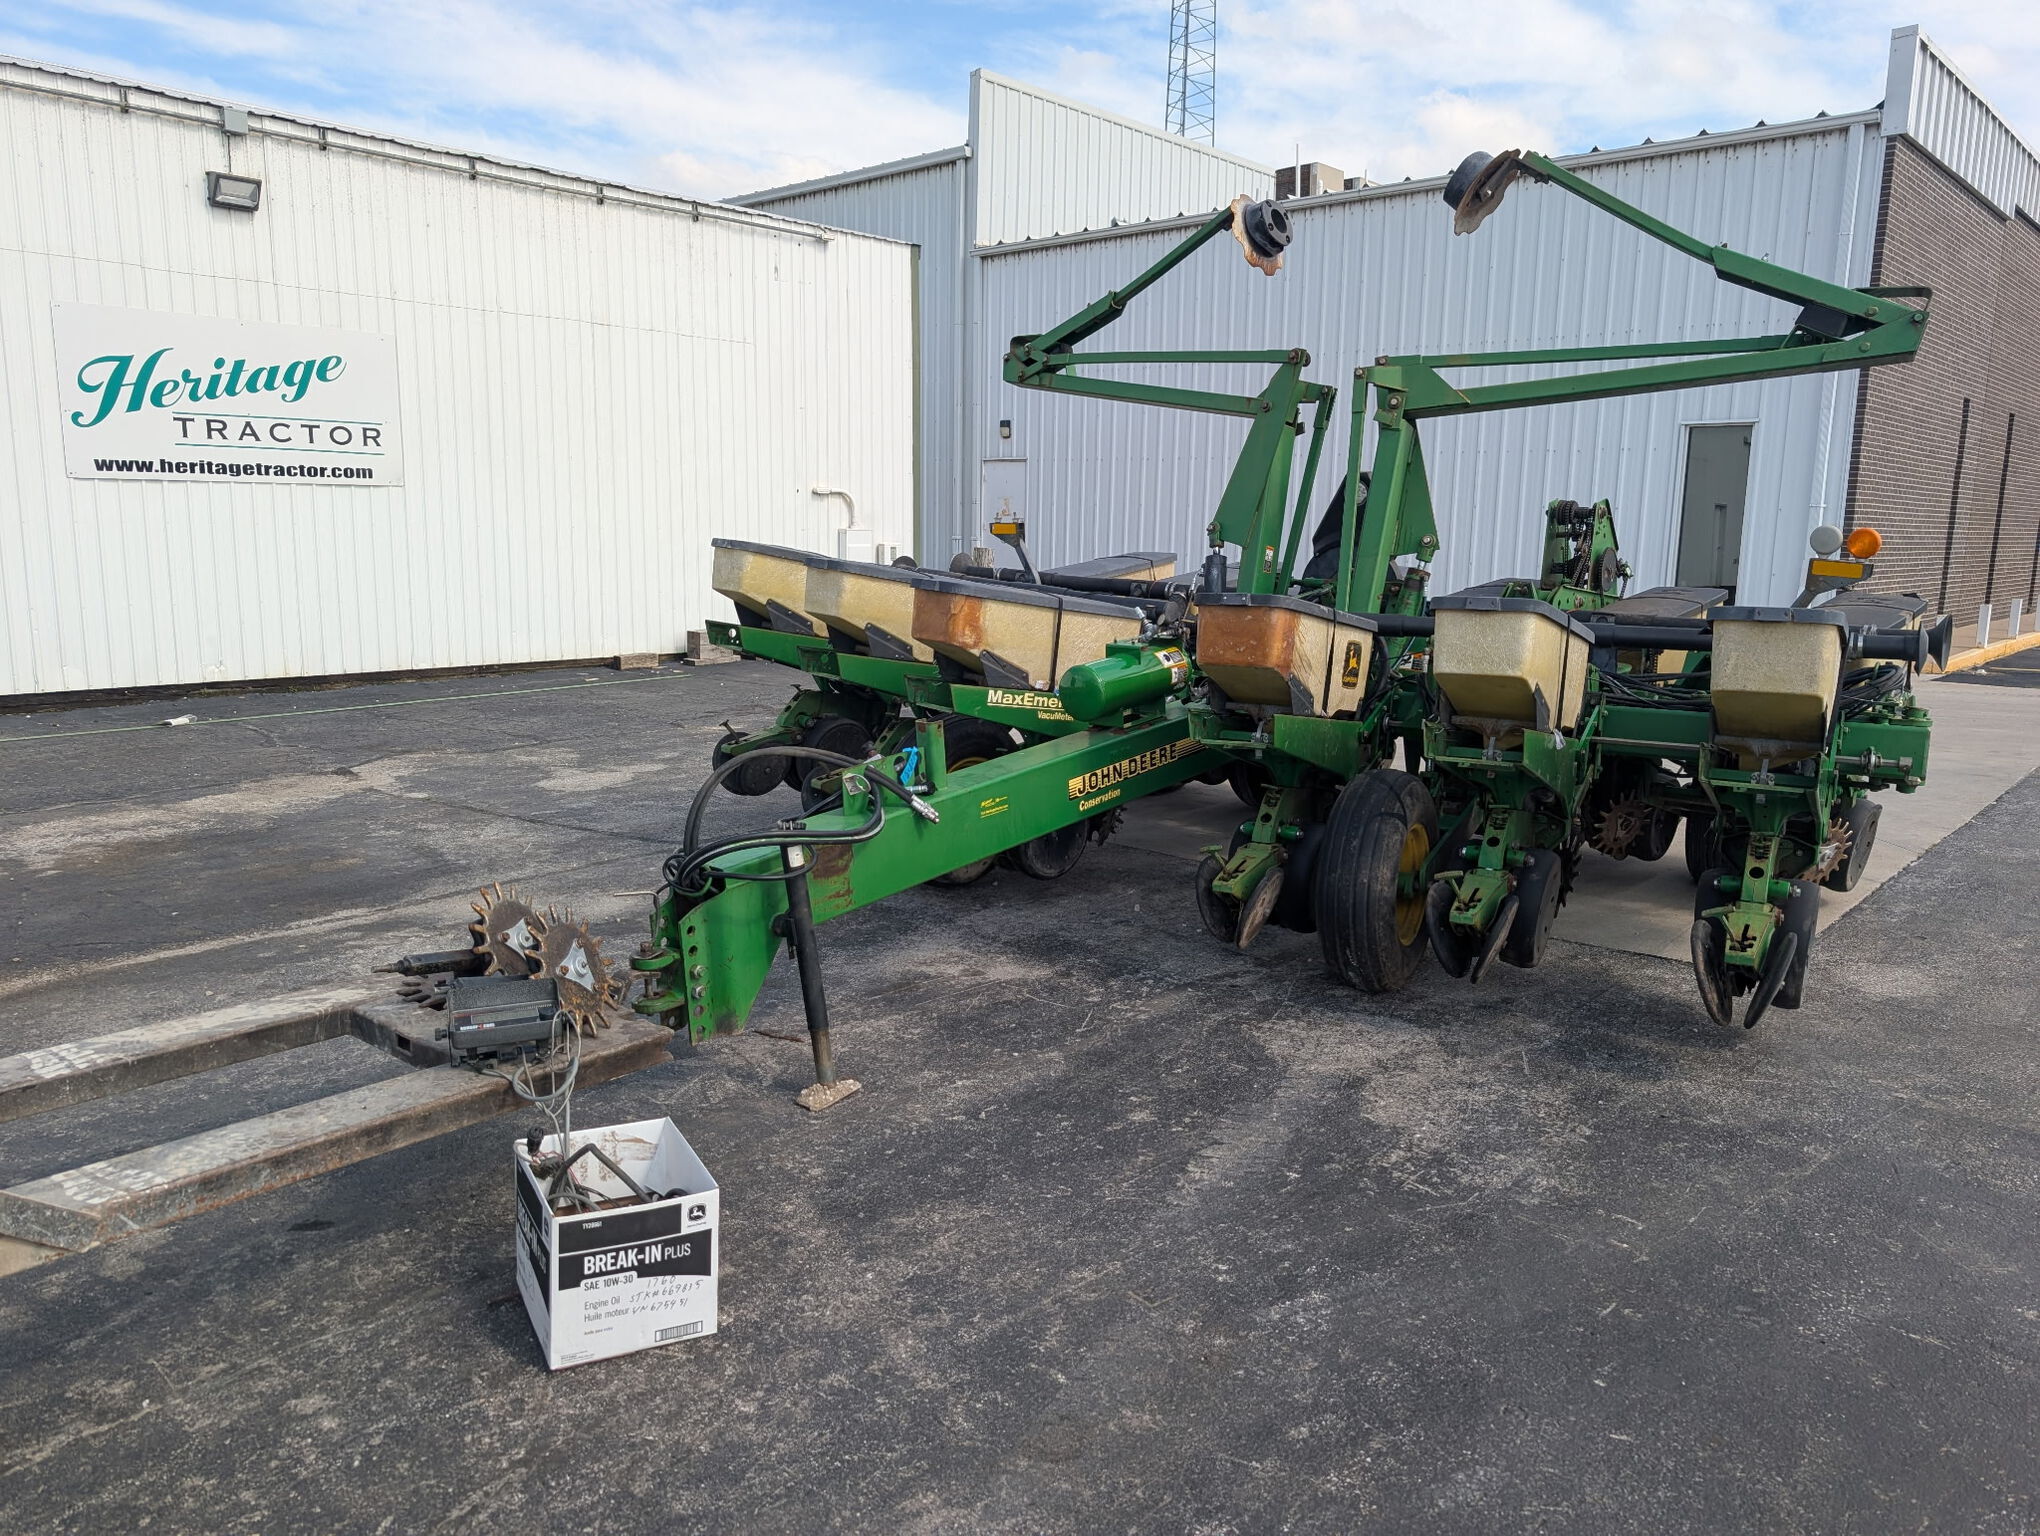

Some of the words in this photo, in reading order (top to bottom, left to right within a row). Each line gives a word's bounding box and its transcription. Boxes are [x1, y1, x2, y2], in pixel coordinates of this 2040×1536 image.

[71, 347, 348, 428] Heritage
[173, 416, 382, 447] TRACTOR
[94, 458, 374, 479] www.heritagetractor.com
[1077, 762, 1123, 795] JOHN
[1128, 743, 1178, 776] DEERE
[1079, 788, 1121, 811] Conservation
[583, 1243, 662, 1275] BREAK-IN
[664, 1243, 692, 1260] PLUS
[584, 1280, 600, 1291] SAE
[603, 1274, 634, 1288] 10W-30
[584, 1299, 609, 1311] Engine
[611, 1296, 621, 1305] Oil
[584, 1312, 602, 1322] Huile
[604, 1307, 630, 1319] moteur
